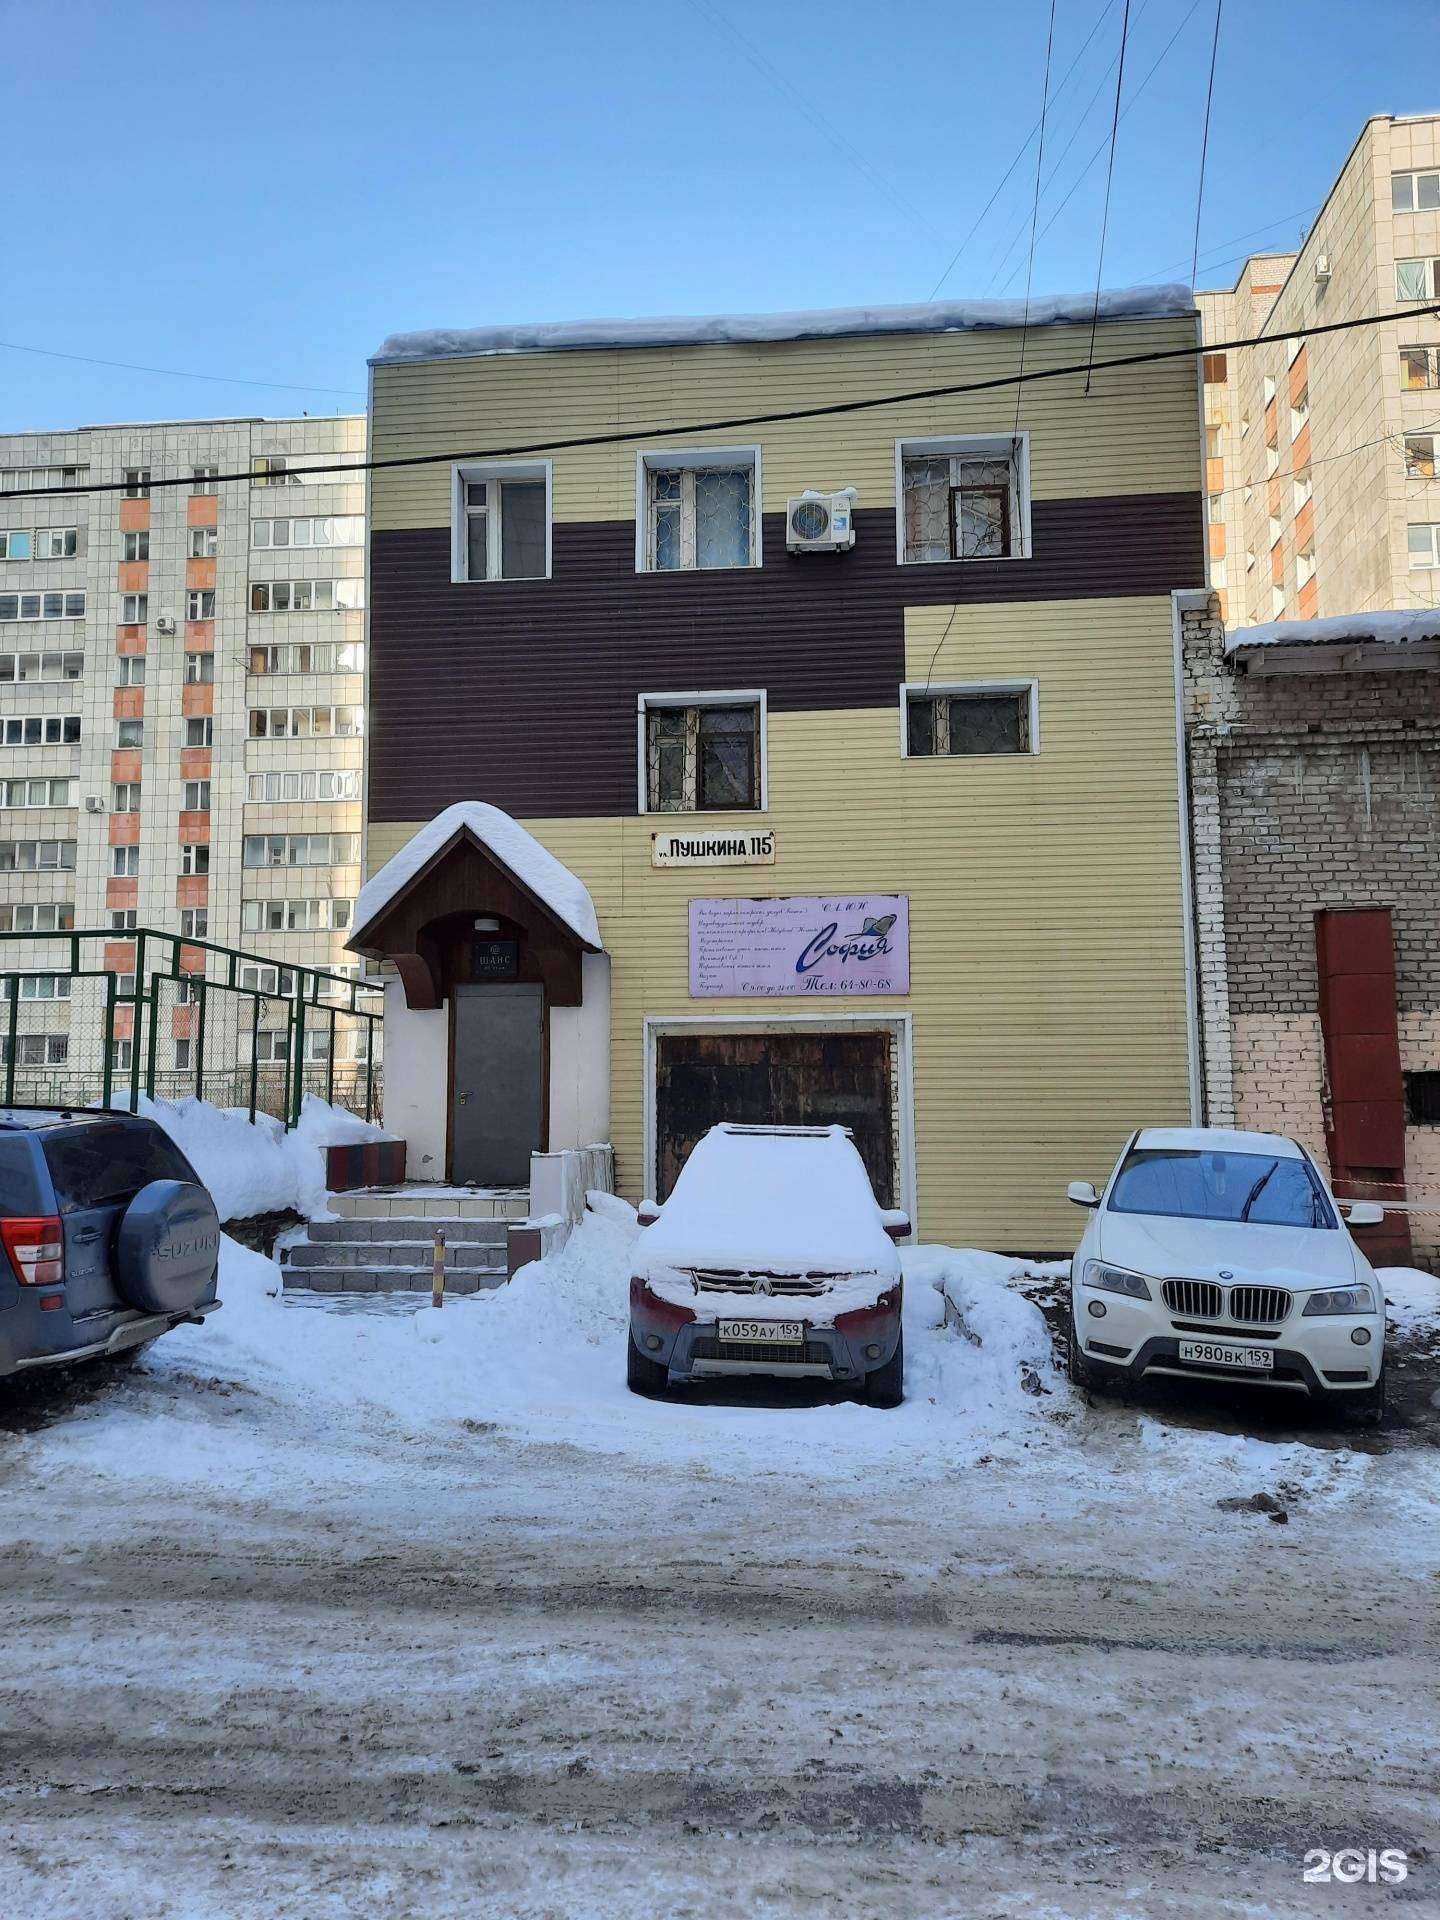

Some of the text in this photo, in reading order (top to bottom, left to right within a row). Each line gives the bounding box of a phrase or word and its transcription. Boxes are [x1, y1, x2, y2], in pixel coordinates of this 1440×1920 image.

[750, 836, 772, 856] 115
[795, 922, 894, 973] София
[779, 1323, 799, 1335] 159
[1246, 1350, 1270, 1362] 159
